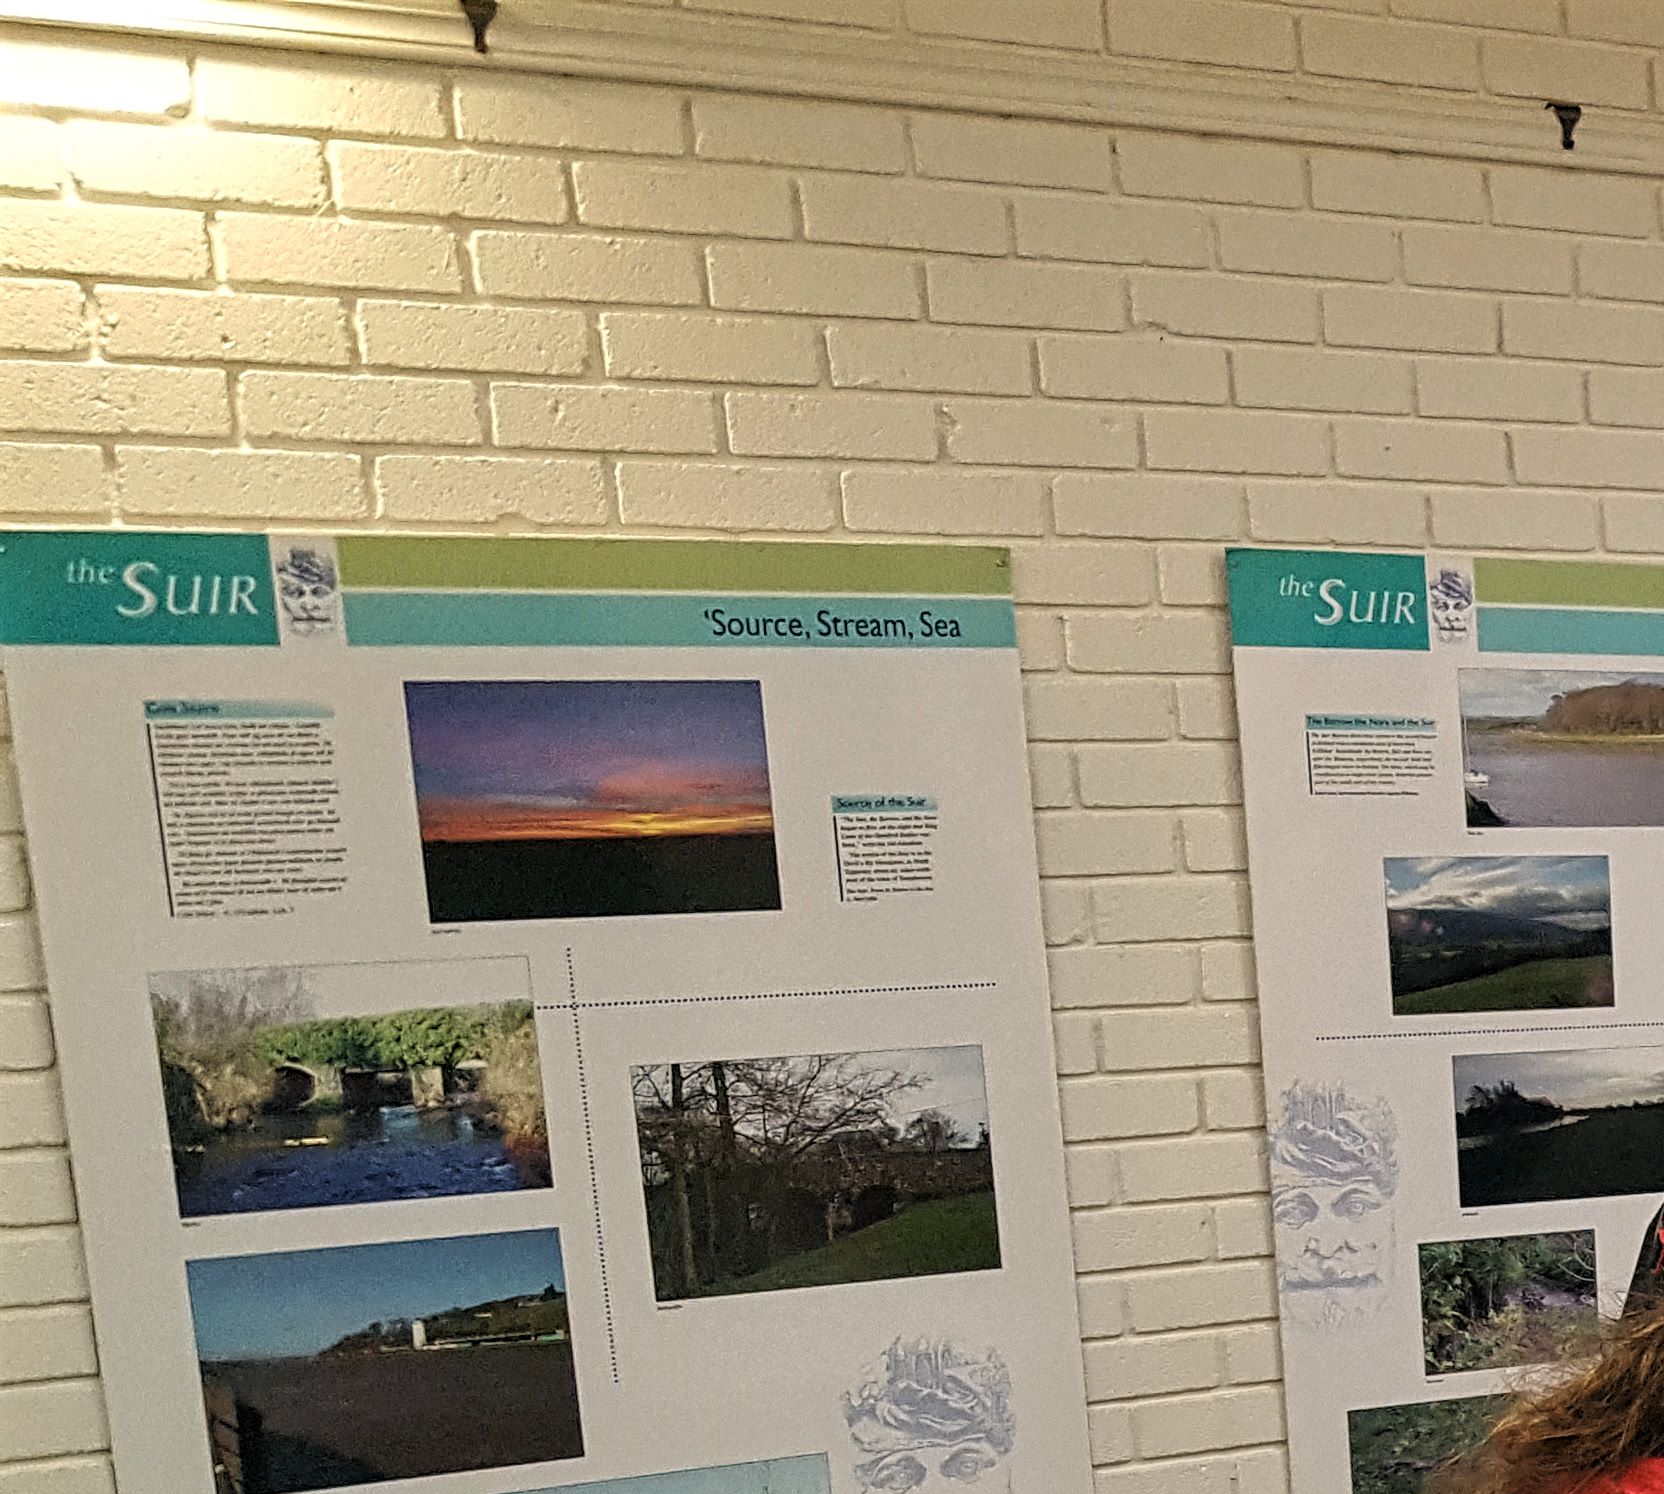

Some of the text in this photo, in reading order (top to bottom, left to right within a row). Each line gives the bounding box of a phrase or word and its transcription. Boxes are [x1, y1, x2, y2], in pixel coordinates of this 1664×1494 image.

[66, 559, 259, 618] the SUIR
[1279, 575, 1416, 625] the SUIR
[817, 607, 914, 640] Stream,
[919, 610, 961, 638] Sea
[837, 796, 926, 808] Source of the Suir
